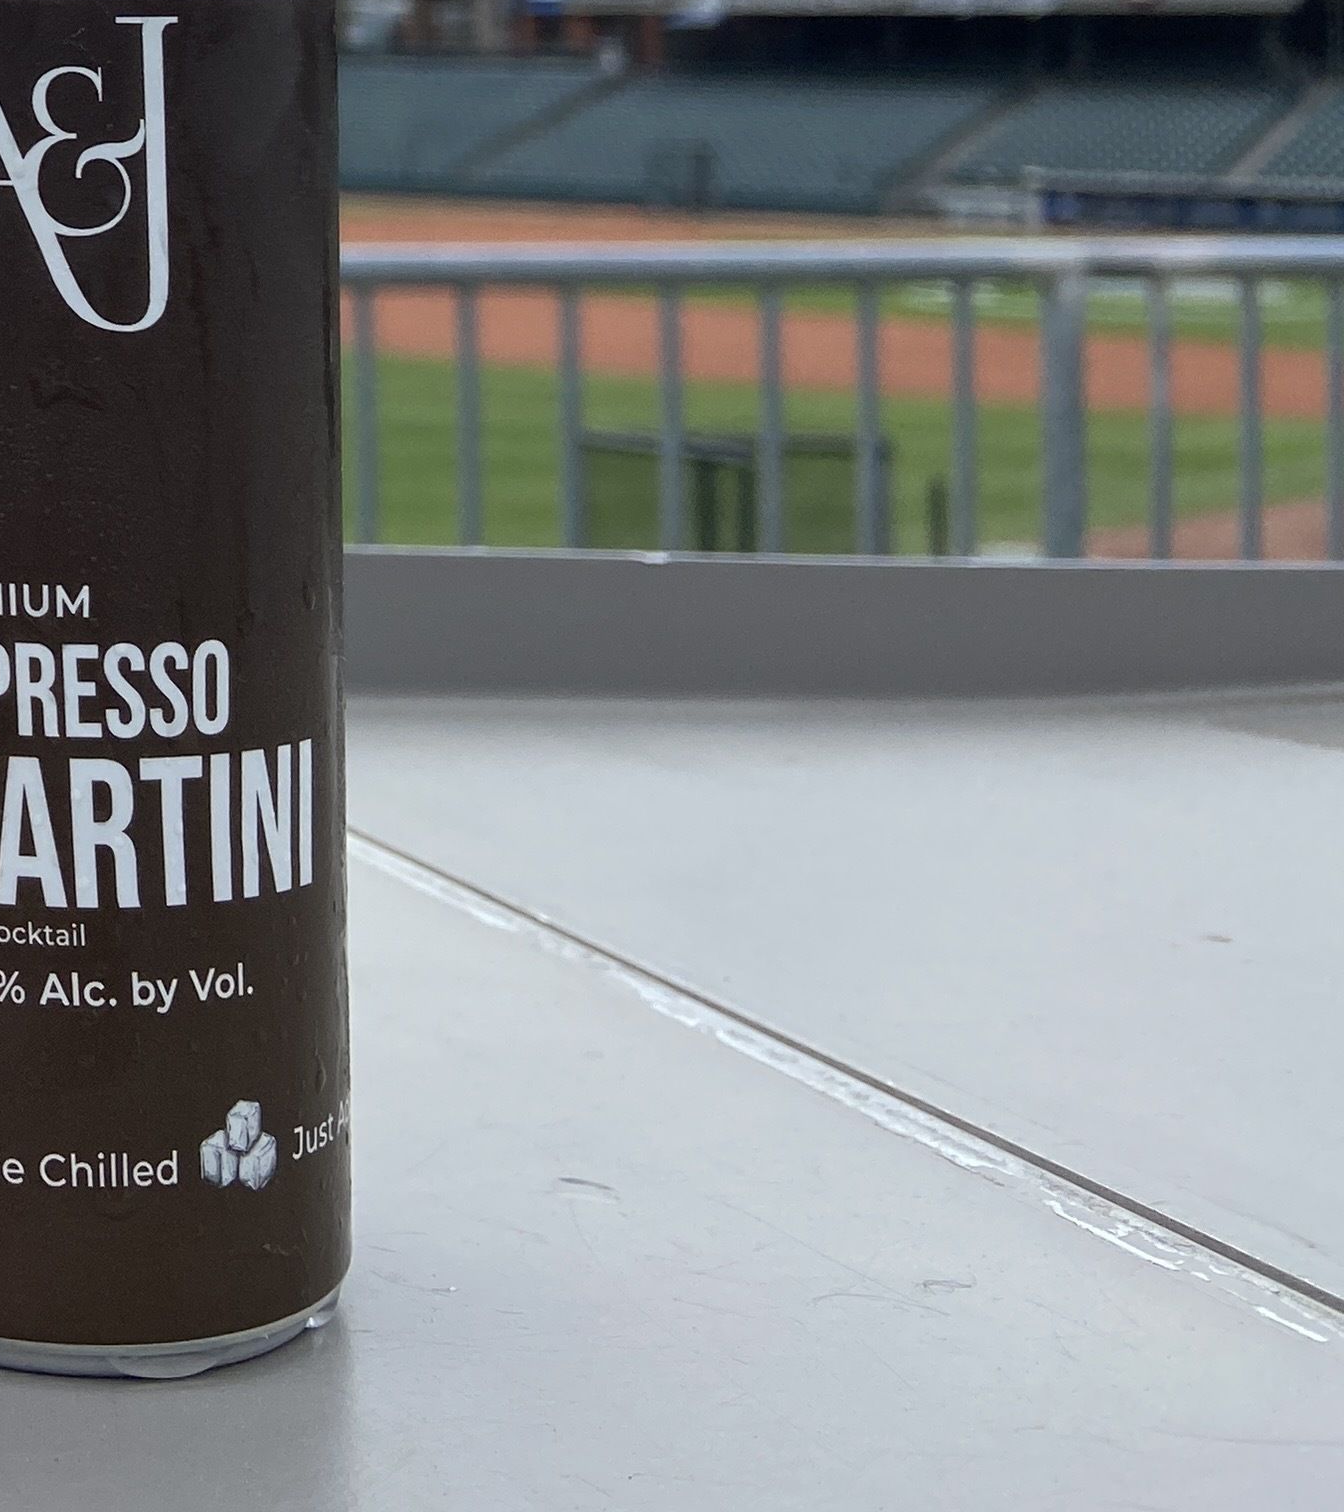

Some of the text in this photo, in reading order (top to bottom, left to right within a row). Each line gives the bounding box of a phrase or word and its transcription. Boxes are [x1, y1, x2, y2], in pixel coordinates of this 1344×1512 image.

[39, 972, 118, 1007] Alc.
[132, 972, 177, 1015] by
[189, 963, 254, 1002] Vol.
[292, 1113, 334, 1160] Just
[38, 1149, 179, 1188] Chilled
